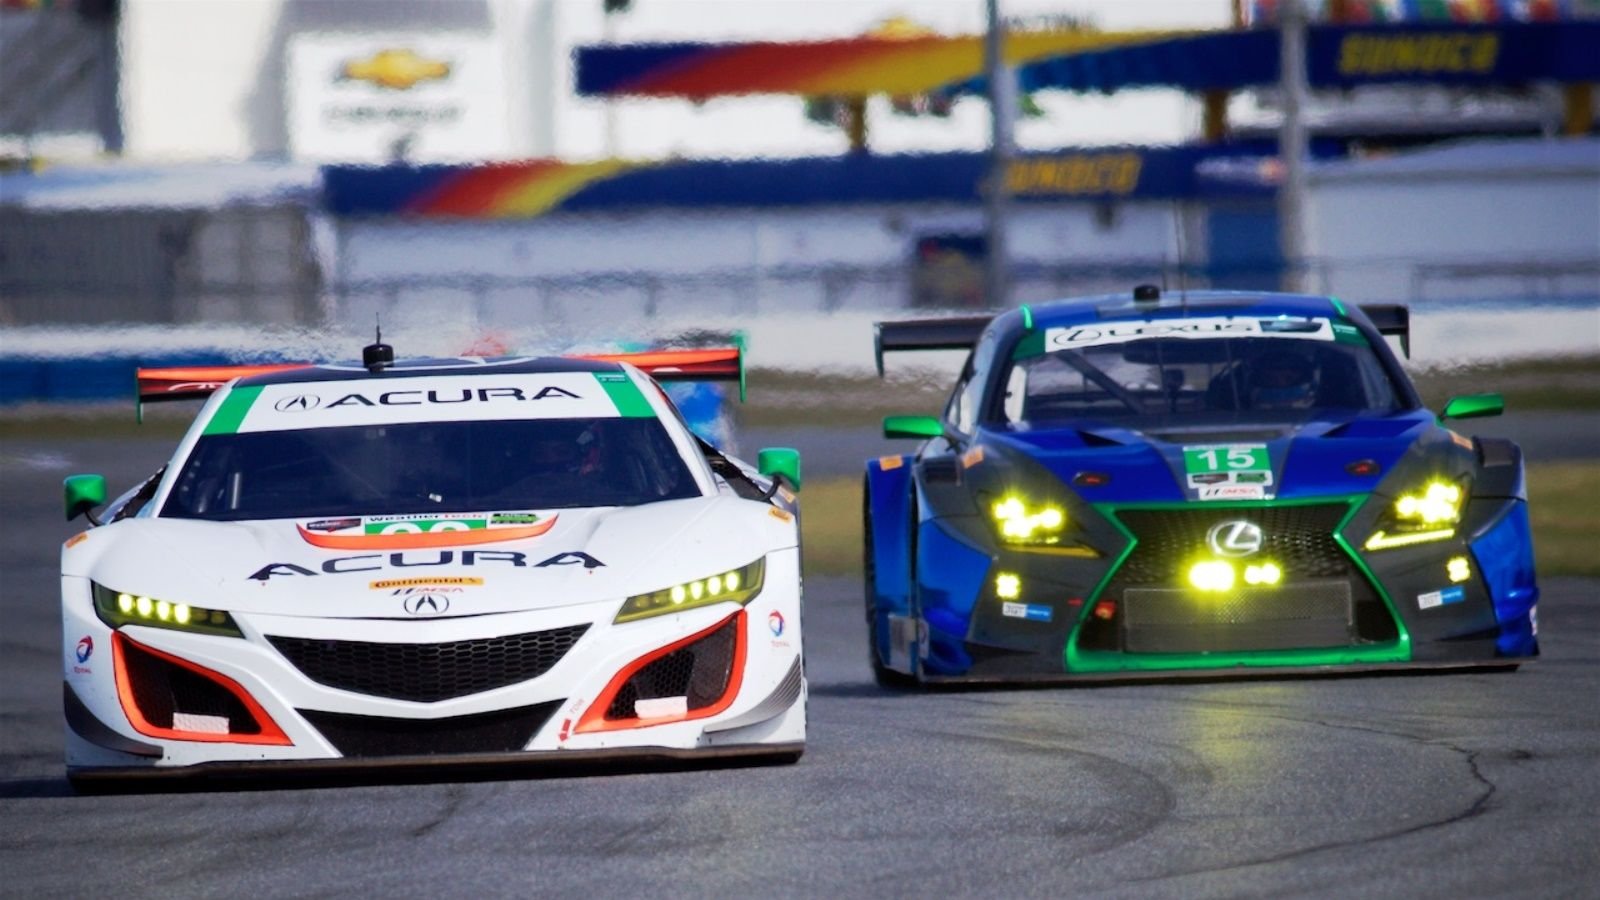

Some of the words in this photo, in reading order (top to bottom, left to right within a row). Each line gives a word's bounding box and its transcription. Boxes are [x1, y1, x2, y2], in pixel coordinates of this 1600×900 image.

[1108, 323, 1253, 337] LEXUS
[324, 386, 583, 409] ACURA
[1196, 449, 1256, 470] 15
[246, 550, 607, 580] ACURA
[374, 577, 464, 588] Continental
